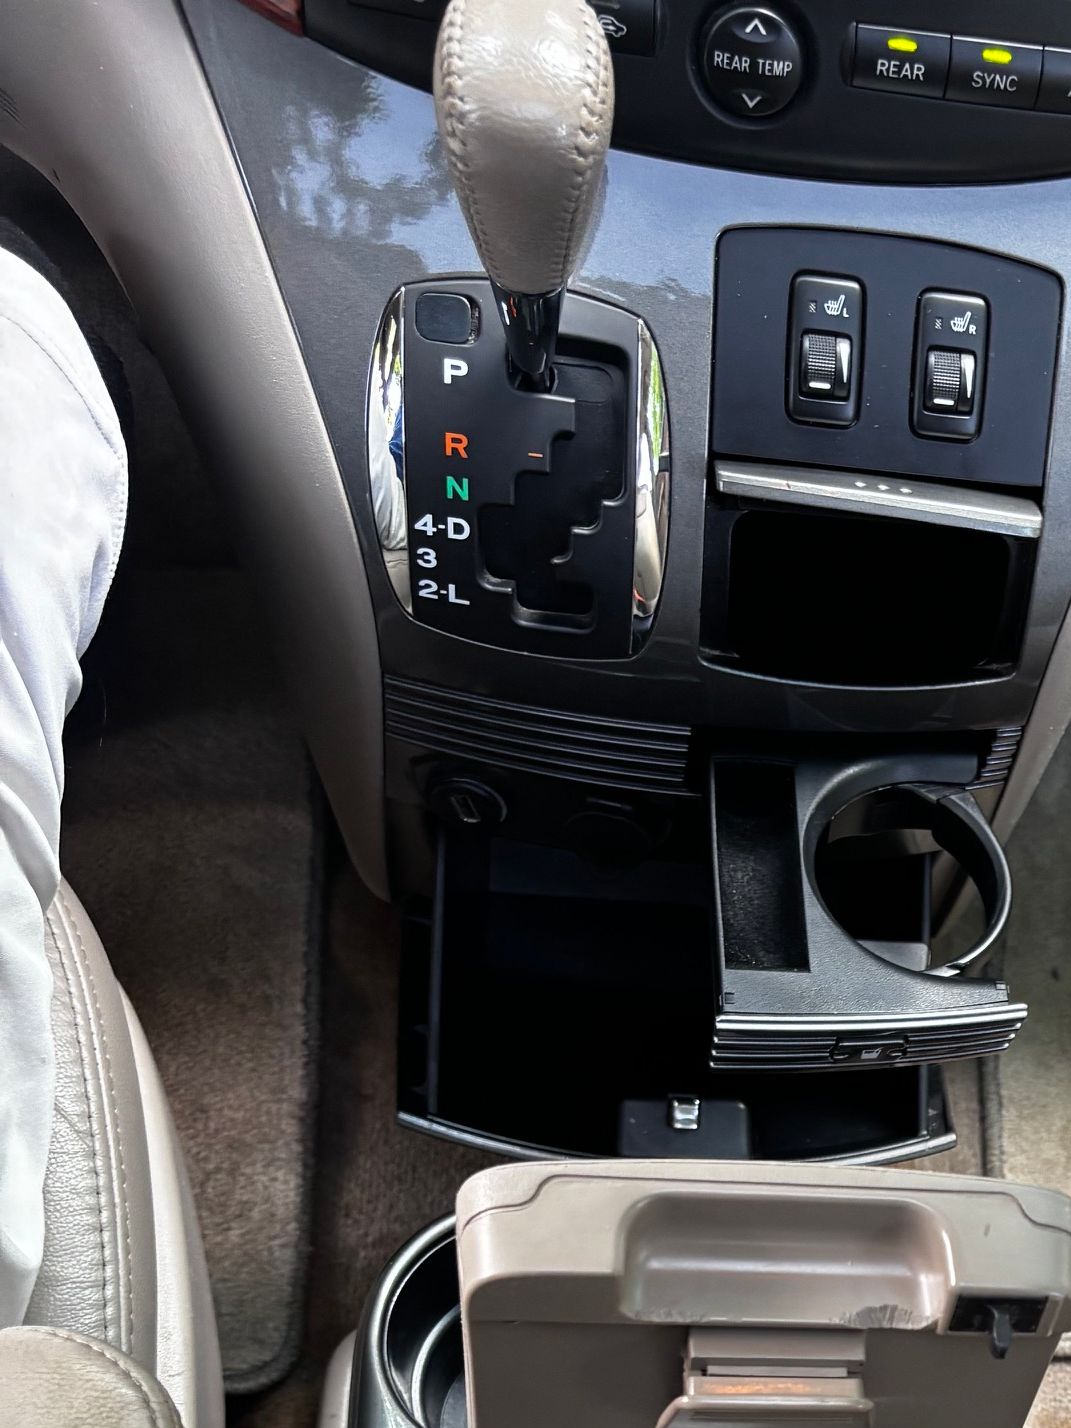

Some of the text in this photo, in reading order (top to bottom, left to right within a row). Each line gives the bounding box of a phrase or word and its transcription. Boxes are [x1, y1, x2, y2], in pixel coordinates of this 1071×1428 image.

[713, 51, 793, 77] REAR TEMP
[876, 60, 924, 82] REAR
[971, 72, 1018, 93] SYNC
[843, 307, 850, 318] L
[969, 324, 977, 335] R
[443, 358, 469, 384] P
[445, 432, 469, 459] R
[446, 476, 469, 501] N
[414, 513, 470, 540] 4-D
[416, 548, 437, 568] 3
[418, 579, 470, 605] 2-L
